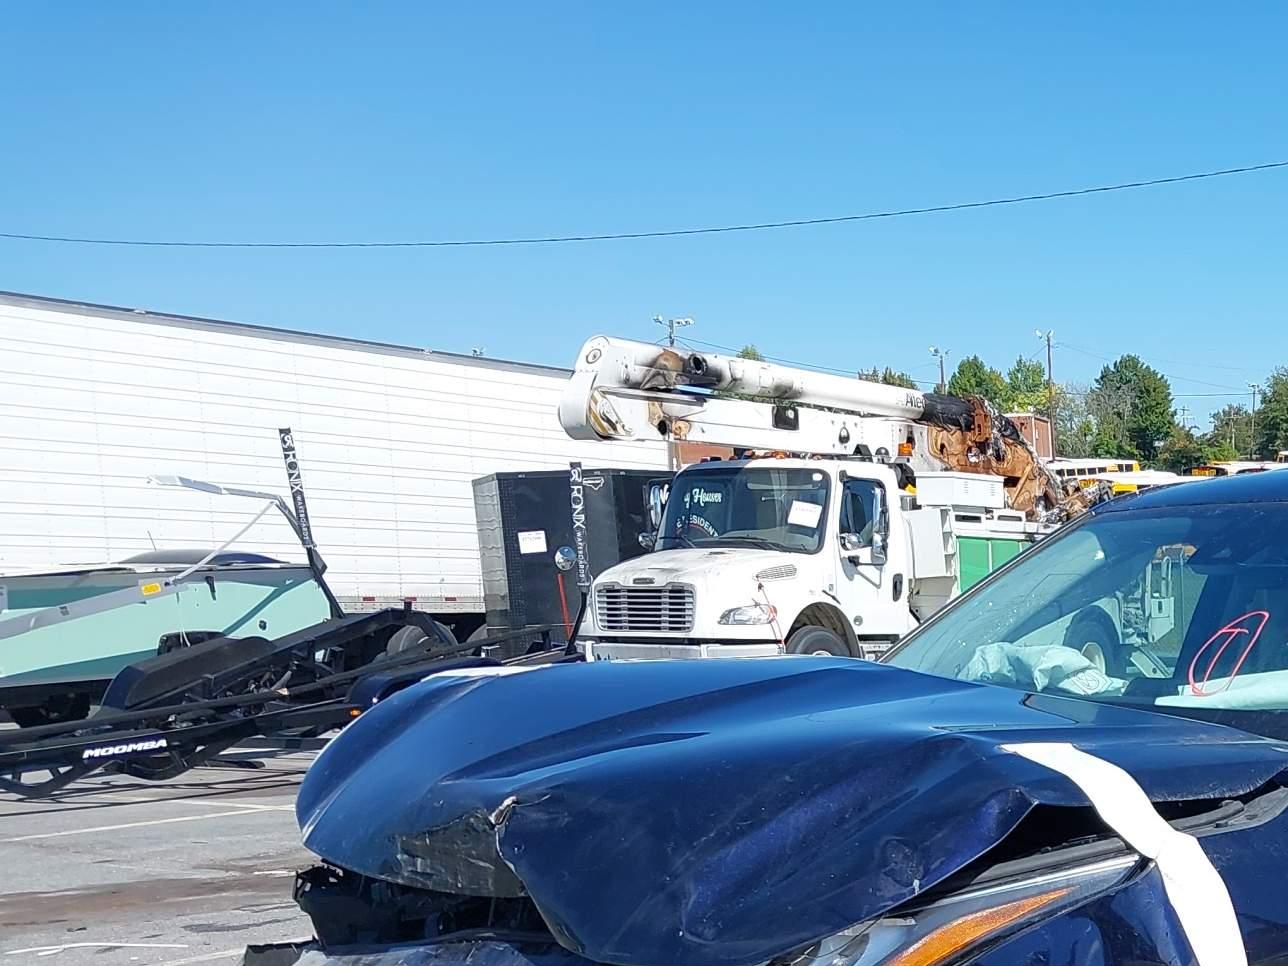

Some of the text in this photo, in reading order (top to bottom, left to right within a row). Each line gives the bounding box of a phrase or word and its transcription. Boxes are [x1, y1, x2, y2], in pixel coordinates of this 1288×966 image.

[284, 451, 308, 540] RONIX WAKEBOARDS
[570, 485, 585, 529] RONIX
[82, 738, 168, 759] MOOMBA
